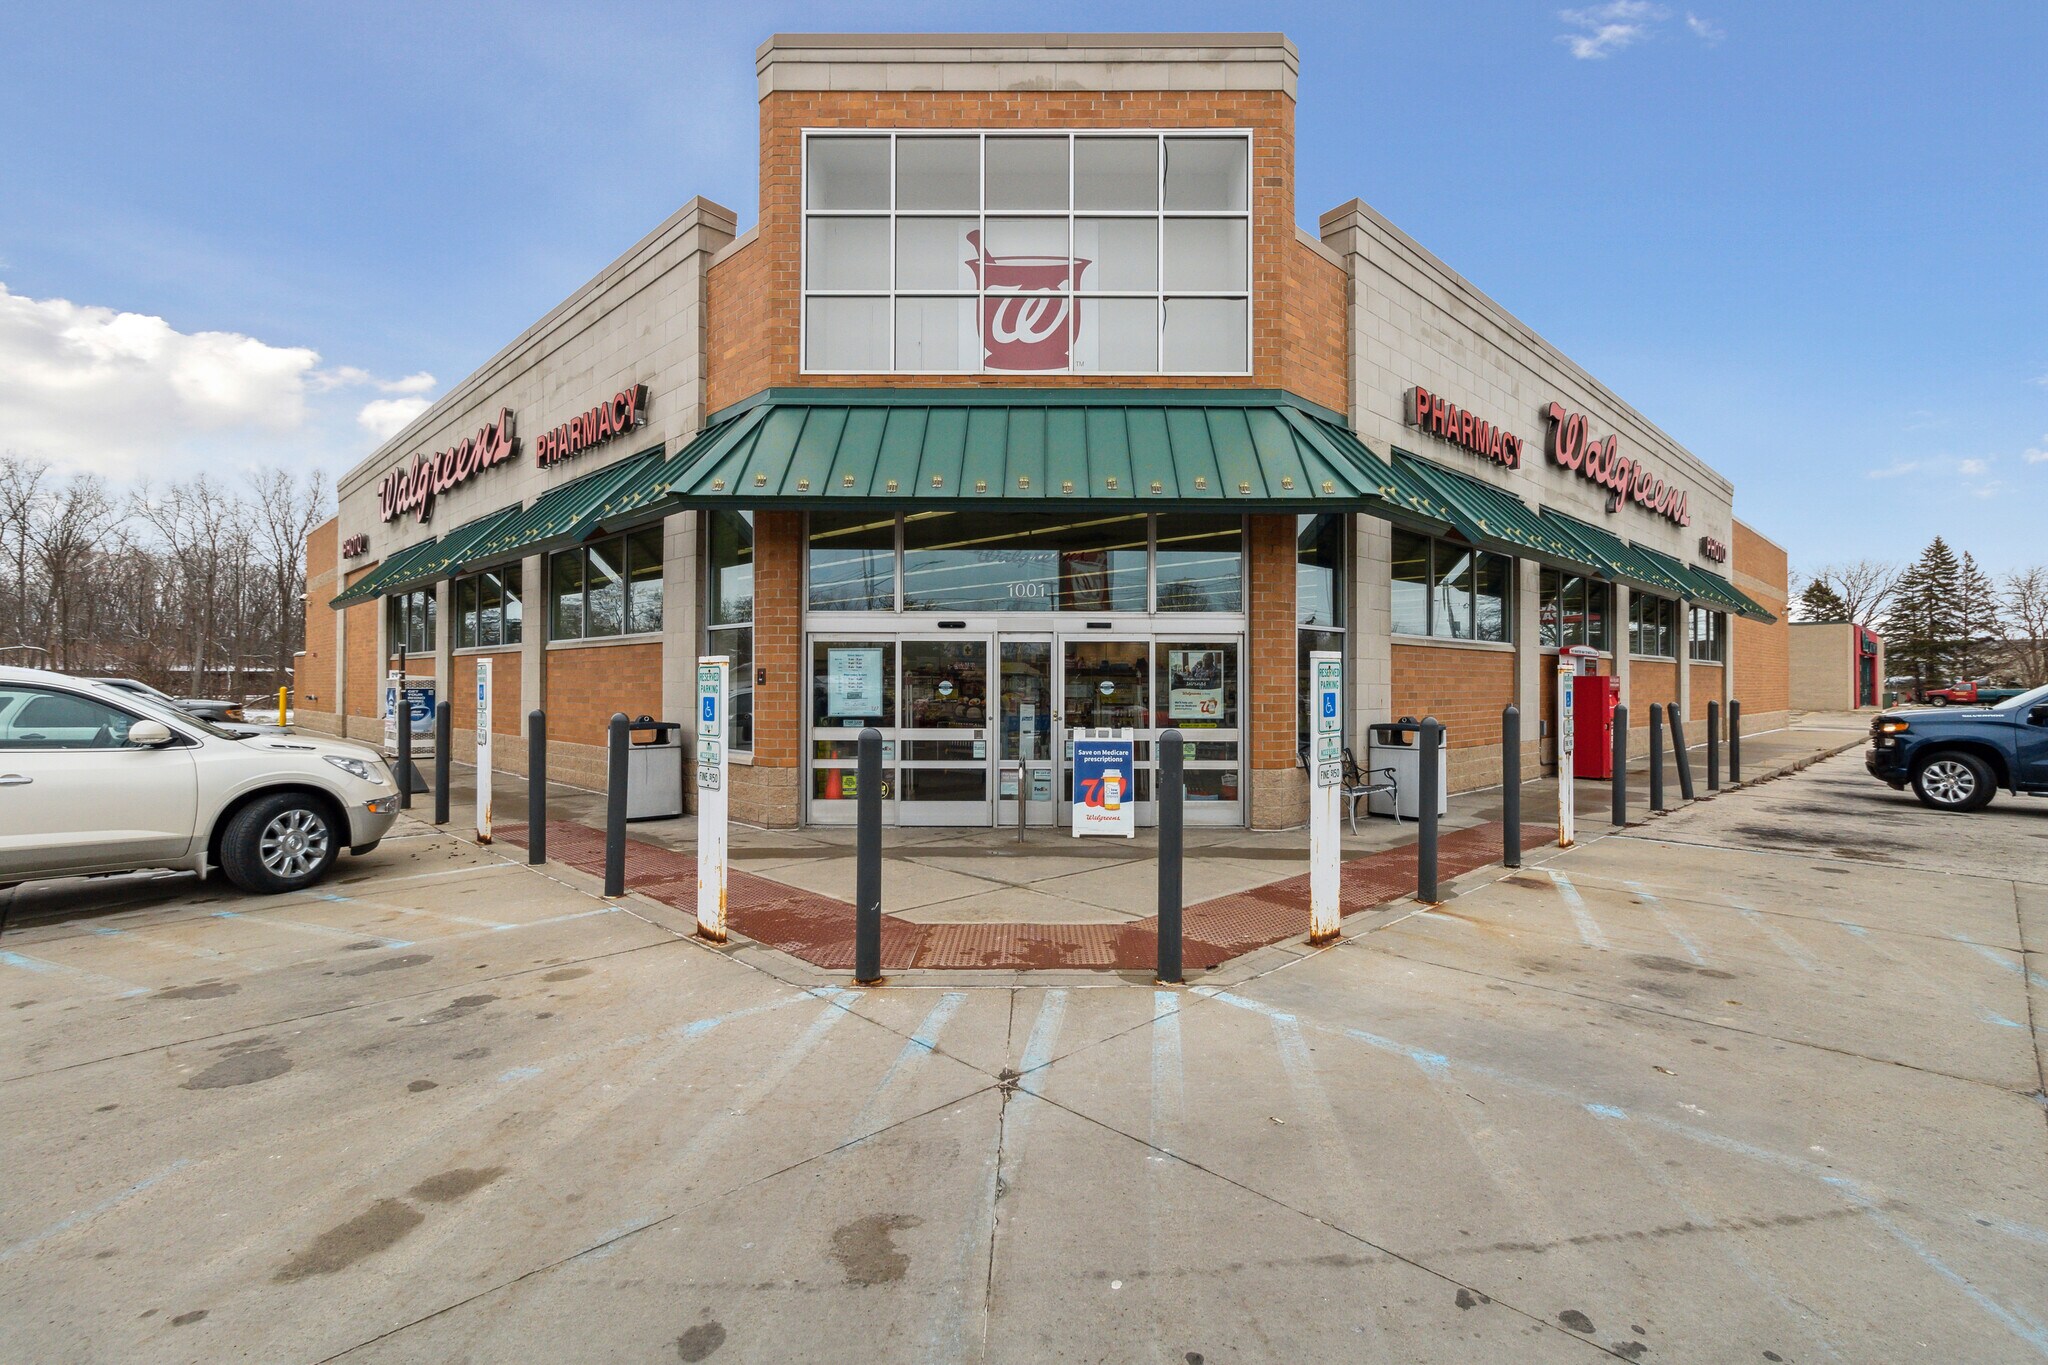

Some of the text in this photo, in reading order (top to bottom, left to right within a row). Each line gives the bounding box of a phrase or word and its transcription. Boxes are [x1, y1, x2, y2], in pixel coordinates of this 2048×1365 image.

[536, 384, 645, 469] PHARMACY
[1413, 385, 1523, 470] PHARMACY
[377, 407, 518, 524] Walgreens
[1546, 401, 1691, 527] Walgreens
[1006, 583, 1045, 597] 1001
[699, 672, 719, 681] RESERVED
[1319, 668, 1340, 678] RESERVED
[700, 684, 719, 694] PARKING
[1320, 680, 1339, 689] PARKING
[699, 771, 708, 782] FINE
[1321, 770, 1329, 780] FINE
[1086, 814, 1121, 822] Walgreens
